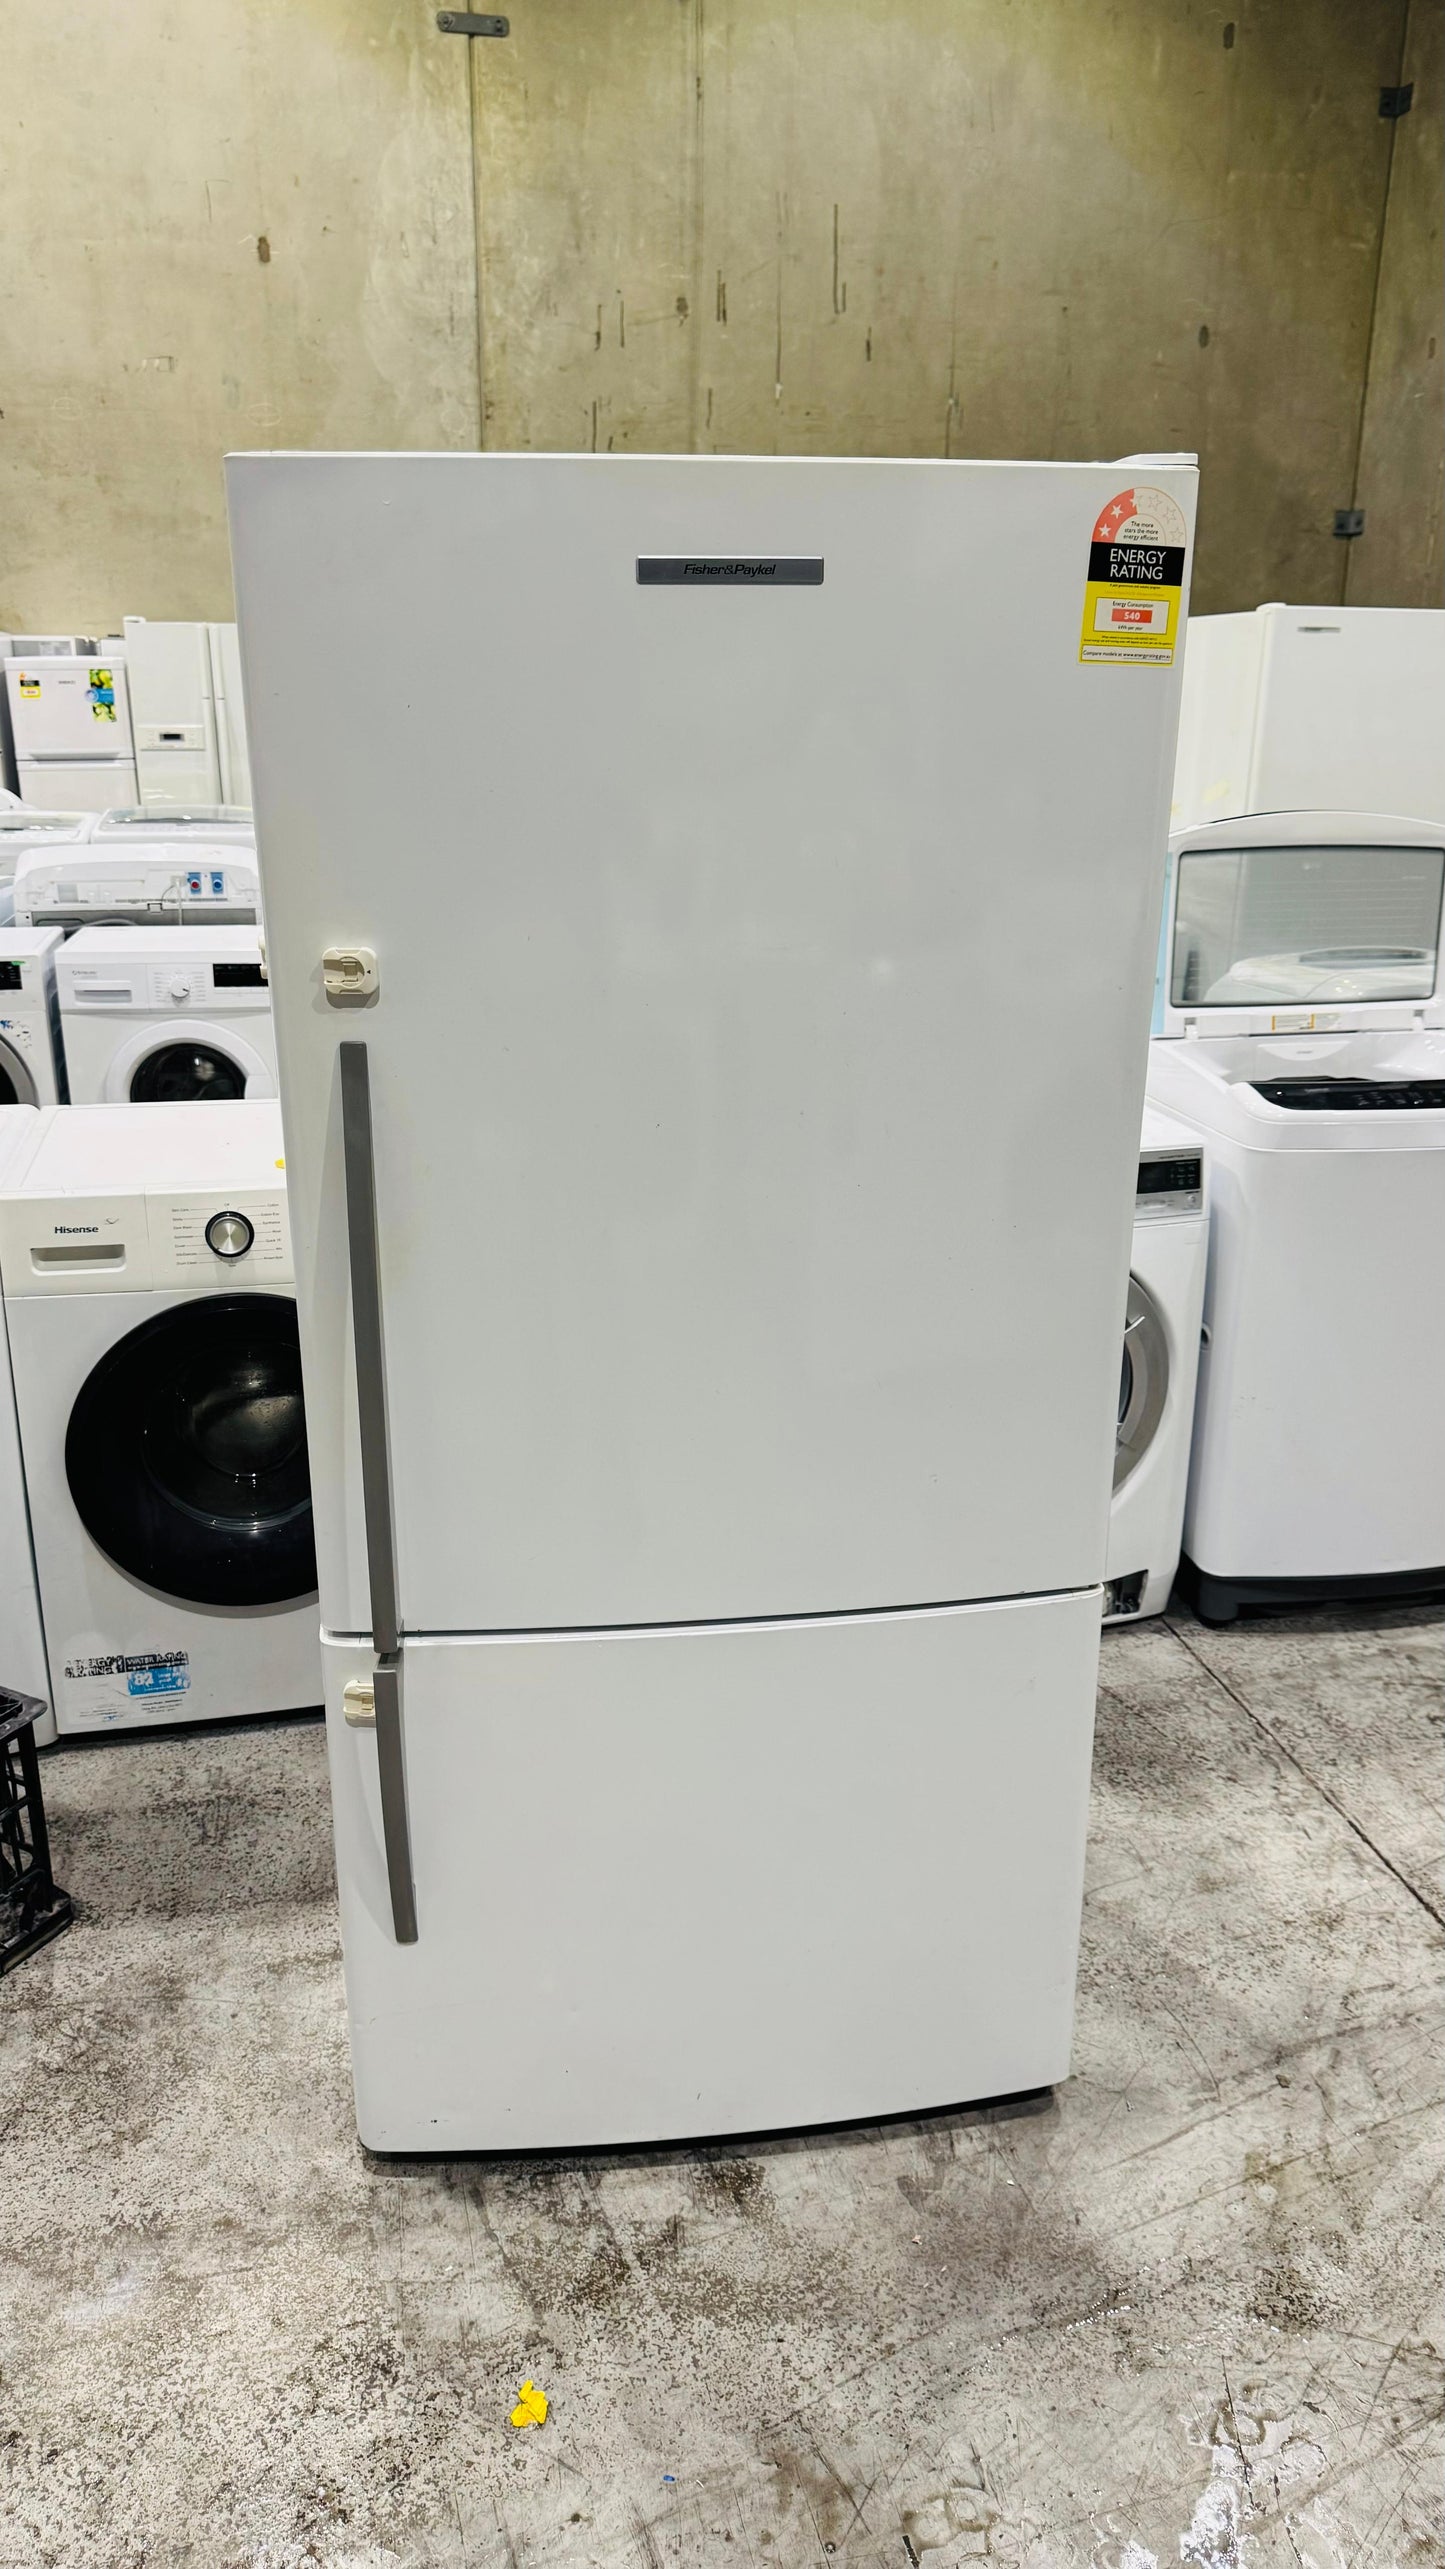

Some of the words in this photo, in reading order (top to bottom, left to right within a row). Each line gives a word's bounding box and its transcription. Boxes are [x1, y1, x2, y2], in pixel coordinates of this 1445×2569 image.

[1109, 548, 1167, 564] ENERGY
[683, 563, 777, 578] Fisher&Paykel
[1109, 563, 1164, 580] RATING
[1112, 600, 1127, 608] Energy
[1127, 601, 1154, 609] Consumption
[1123, 611, 1141, 620] 540
[54, 1225, 99, 1234] Hisense
